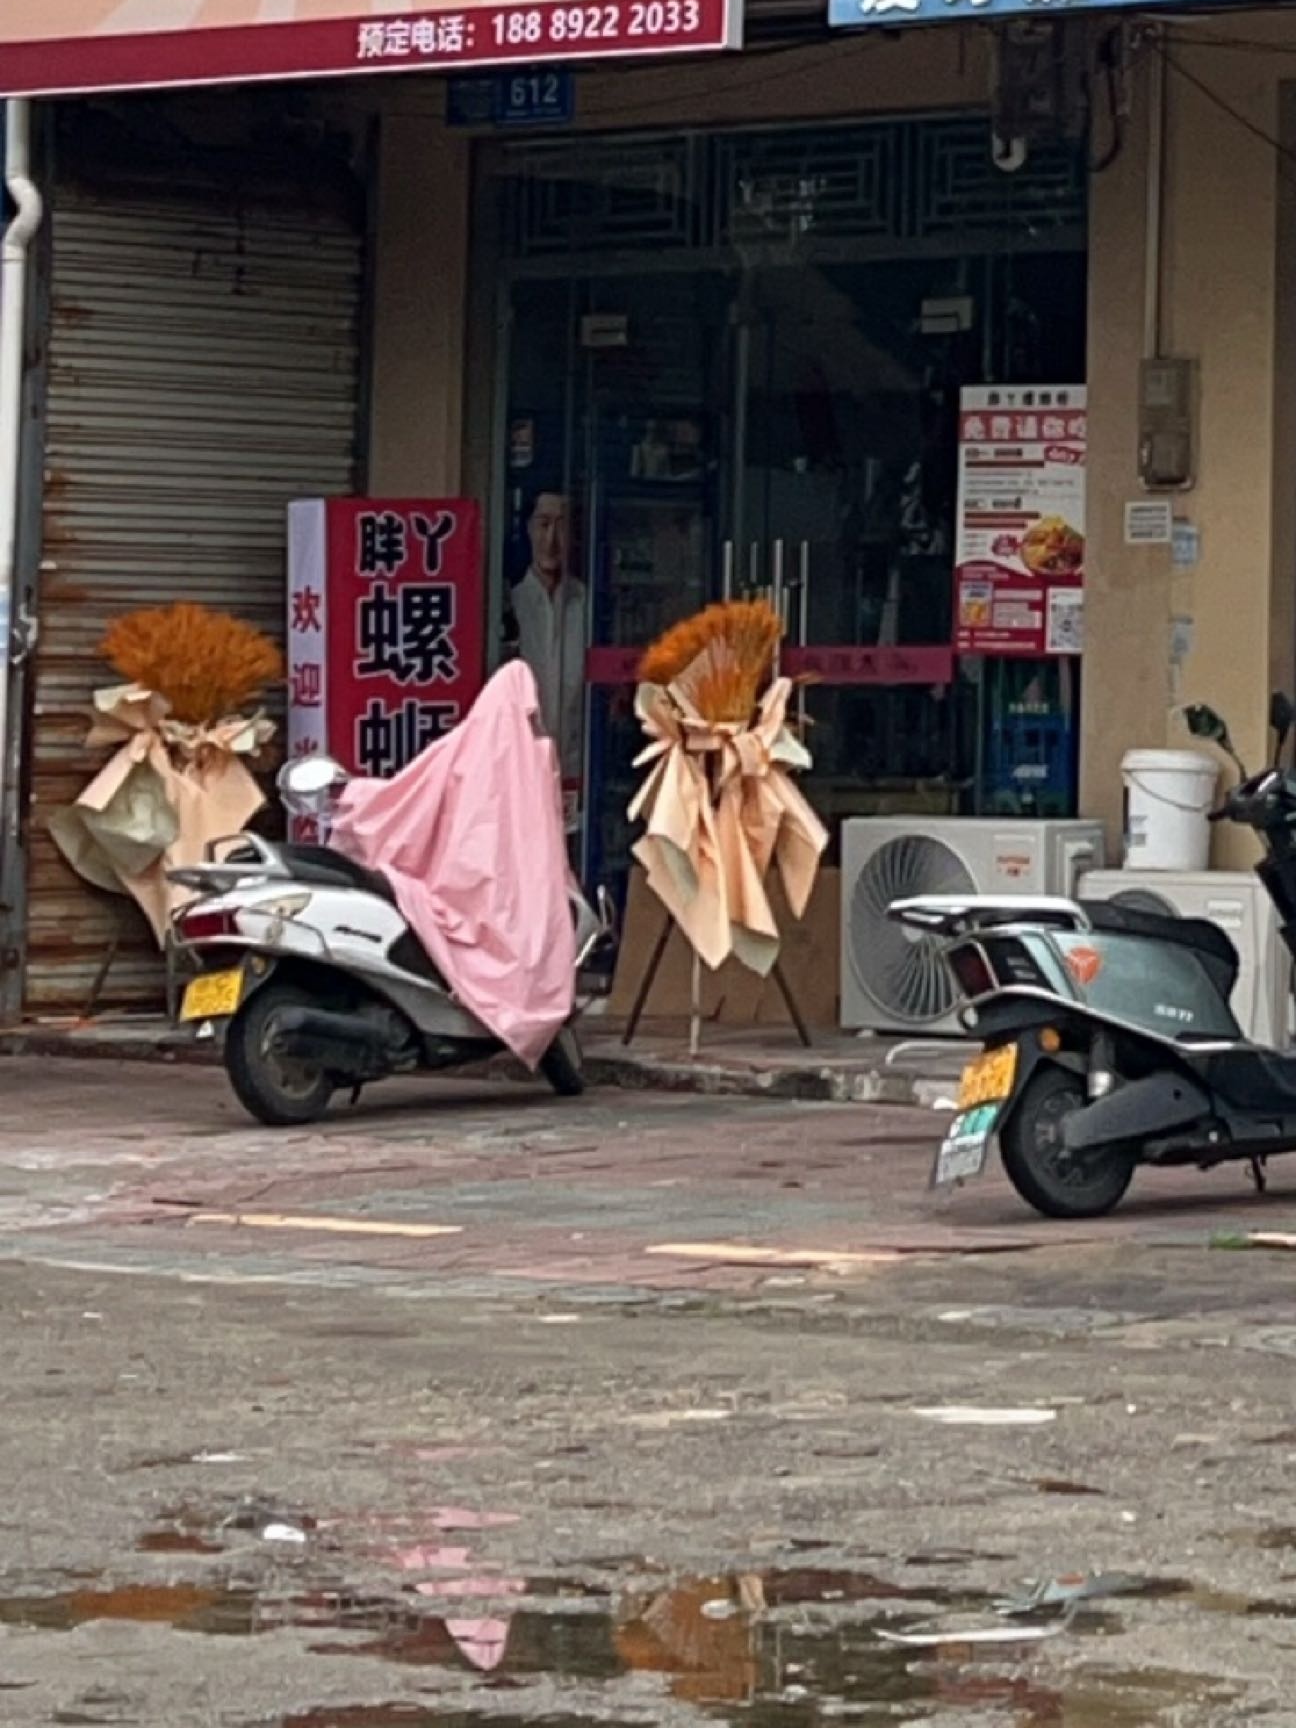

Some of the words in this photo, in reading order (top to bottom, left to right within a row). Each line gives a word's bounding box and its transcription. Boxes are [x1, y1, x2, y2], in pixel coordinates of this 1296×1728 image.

[491, 12, 541, 44] 188
[549, 6, 619, 41] 8922
[627, 0, 700, 35] 2033
[510, 74, 559, 106] 612
[356, 512, 455, 575] 胖丫
